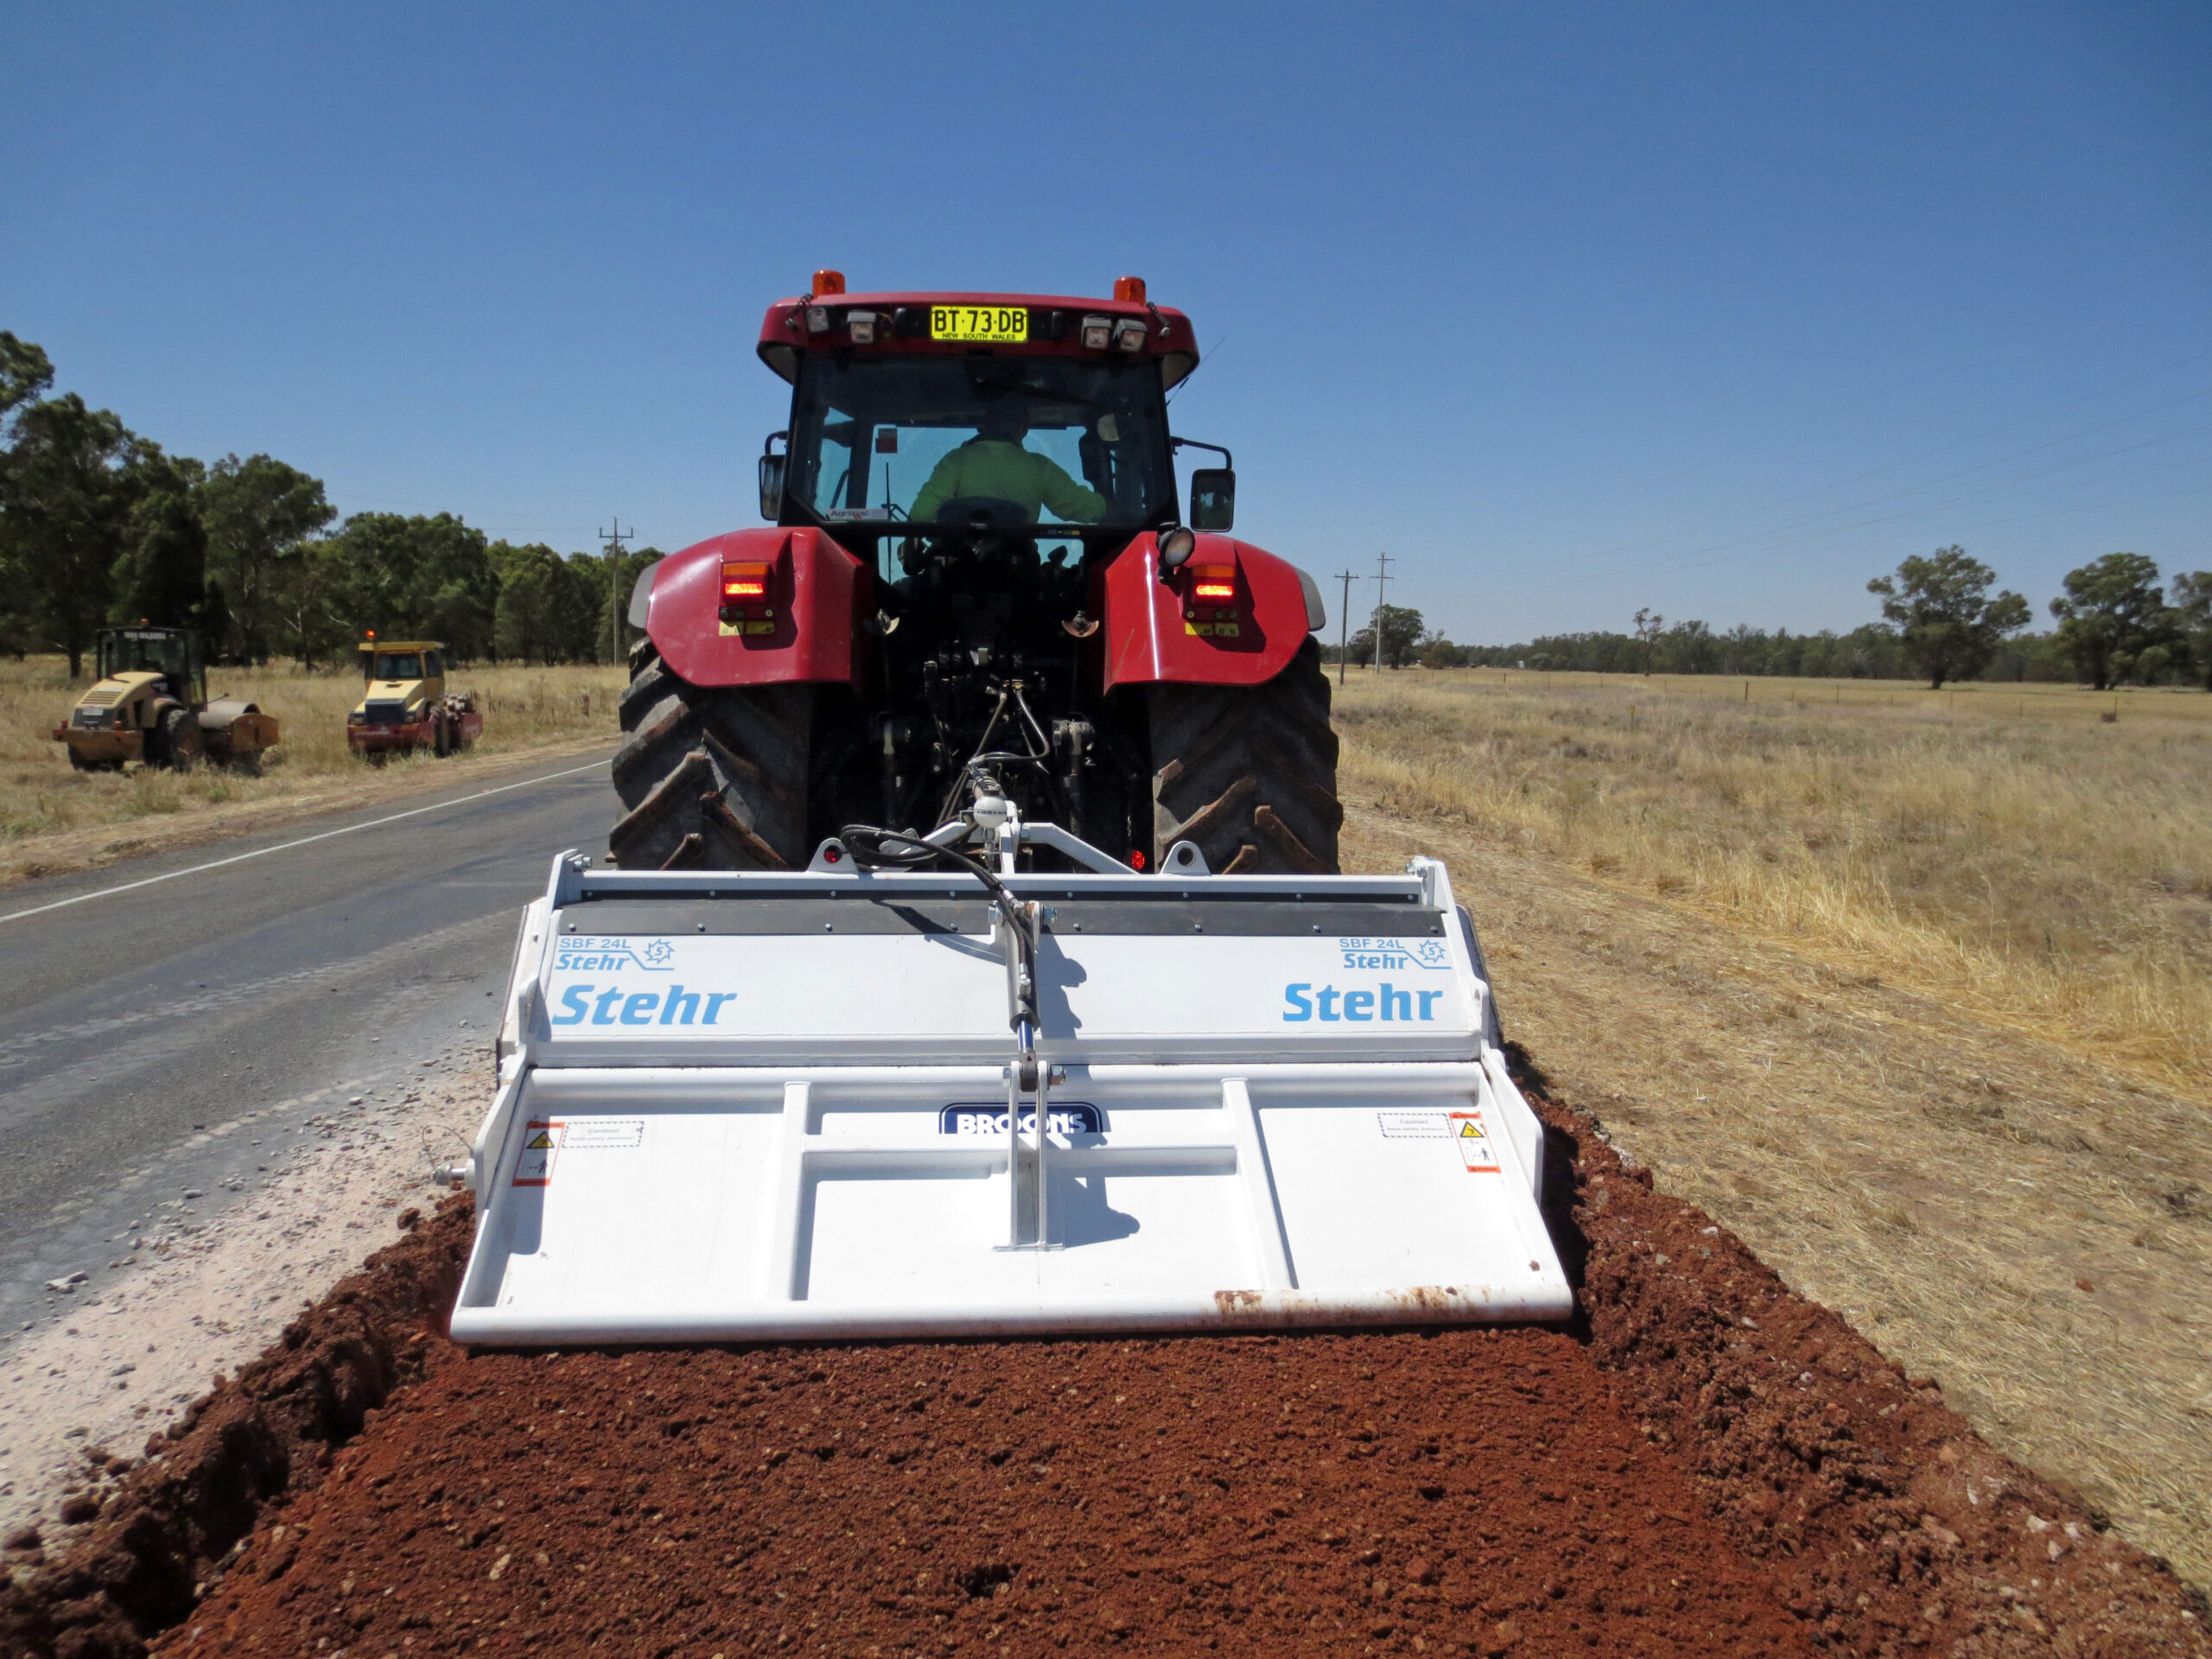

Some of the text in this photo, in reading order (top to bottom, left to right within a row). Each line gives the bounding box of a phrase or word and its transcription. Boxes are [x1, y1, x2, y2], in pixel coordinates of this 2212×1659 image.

[559, 938, 632, 949] SBF 24L
[1339, 938, 1405, 949] SBF 24L
[555, 954, 631, 970] Stehr
[1344, 953, 1408, 969] Stehr
[551, 985, 737, 1026] Stehr
[1283, 983, 1443, 1021] Stehr
